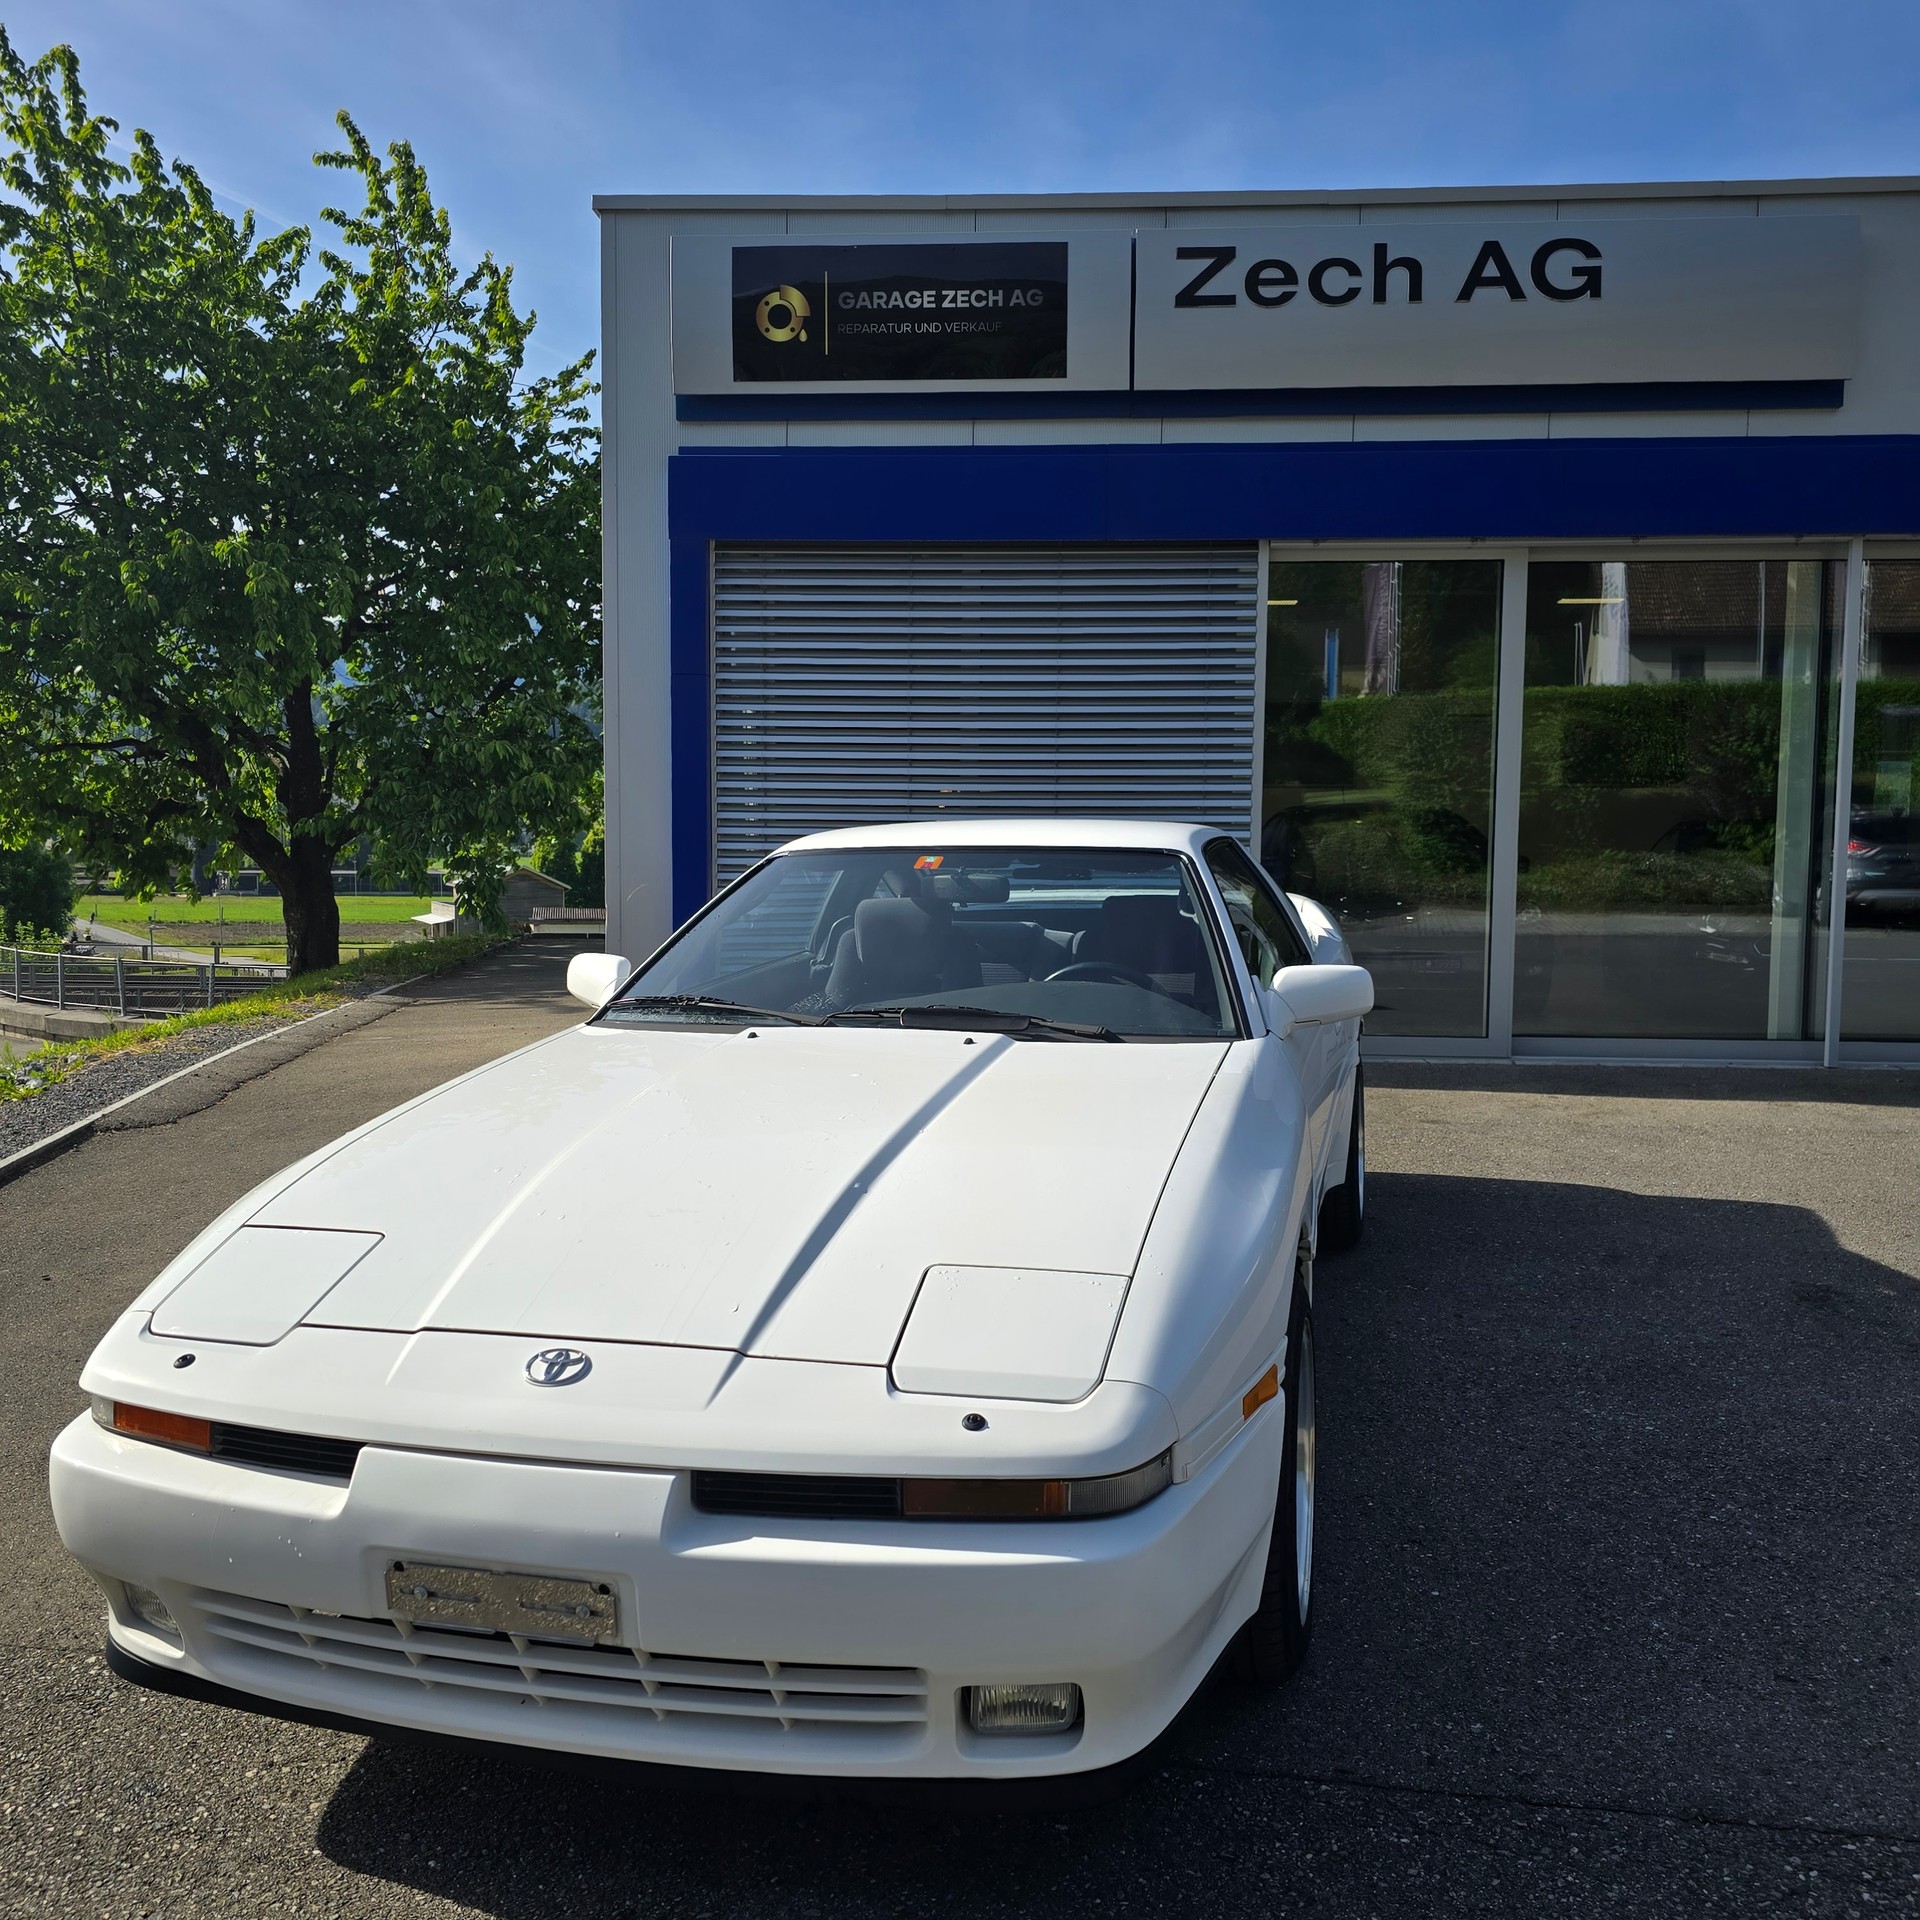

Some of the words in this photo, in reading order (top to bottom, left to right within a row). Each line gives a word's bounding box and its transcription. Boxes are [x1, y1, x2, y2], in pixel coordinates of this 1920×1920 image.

[1174, 242, 1423, 309] Zech
[1454, 237, 1603, 303] AG
[838, 290, 936, 309] GARAGE
[941, 289, 1003, 308] ZECH
[1009, 288, 1044, 307] AG
[838, 322, 912, 334] REPARATUR
[915, 322, 942, 334] UND
[944, 321, 1002, 333] VERKAUF
